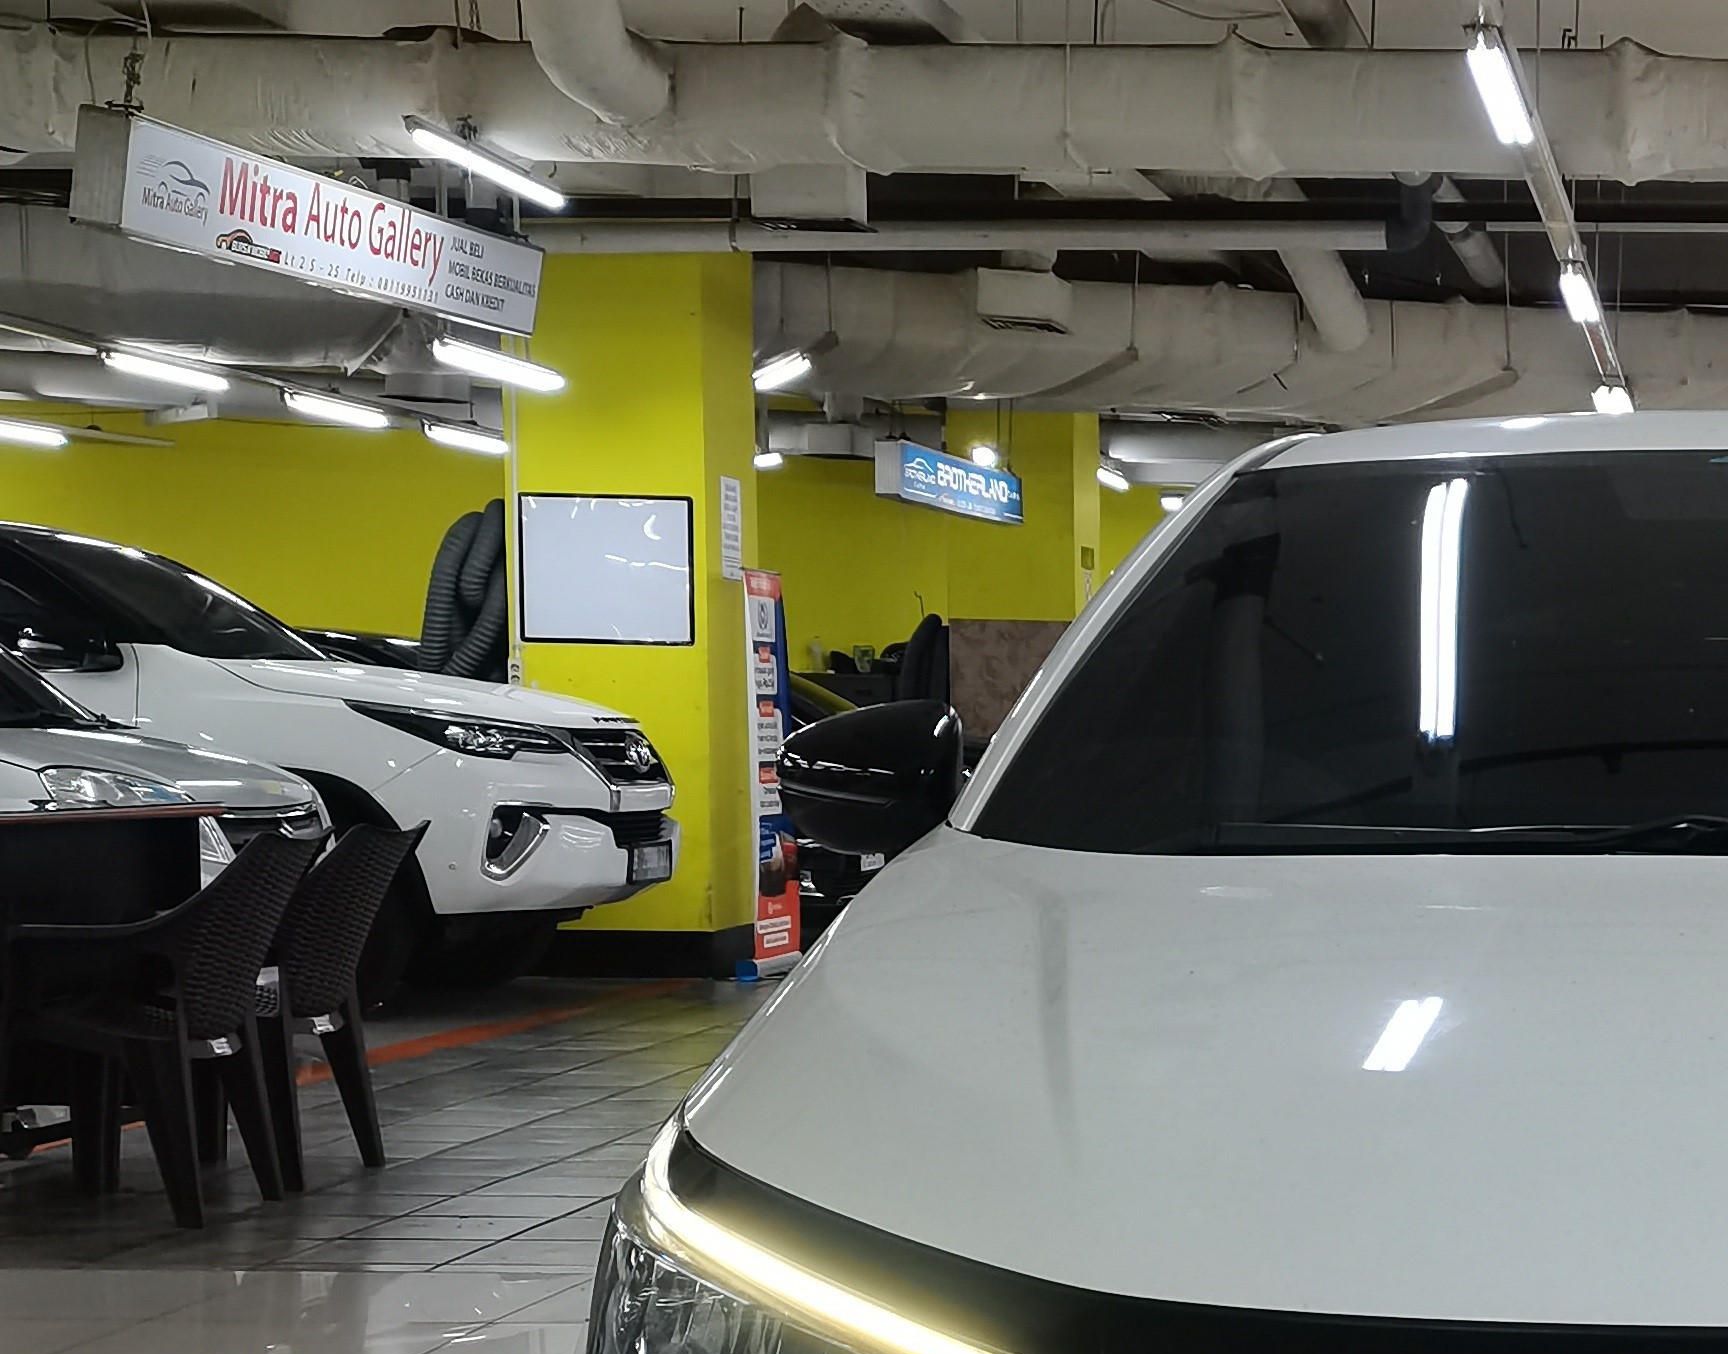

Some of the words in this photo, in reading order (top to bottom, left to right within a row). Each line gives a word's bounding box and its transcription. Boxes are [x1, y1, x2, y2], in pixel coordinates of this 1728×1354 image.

[142, 186, 165, 210] Mitra
[219, 157, 298, 235] Mitra
[304, 182, 362, 250] Auto
[368, 201, 444, 287] Gallery
